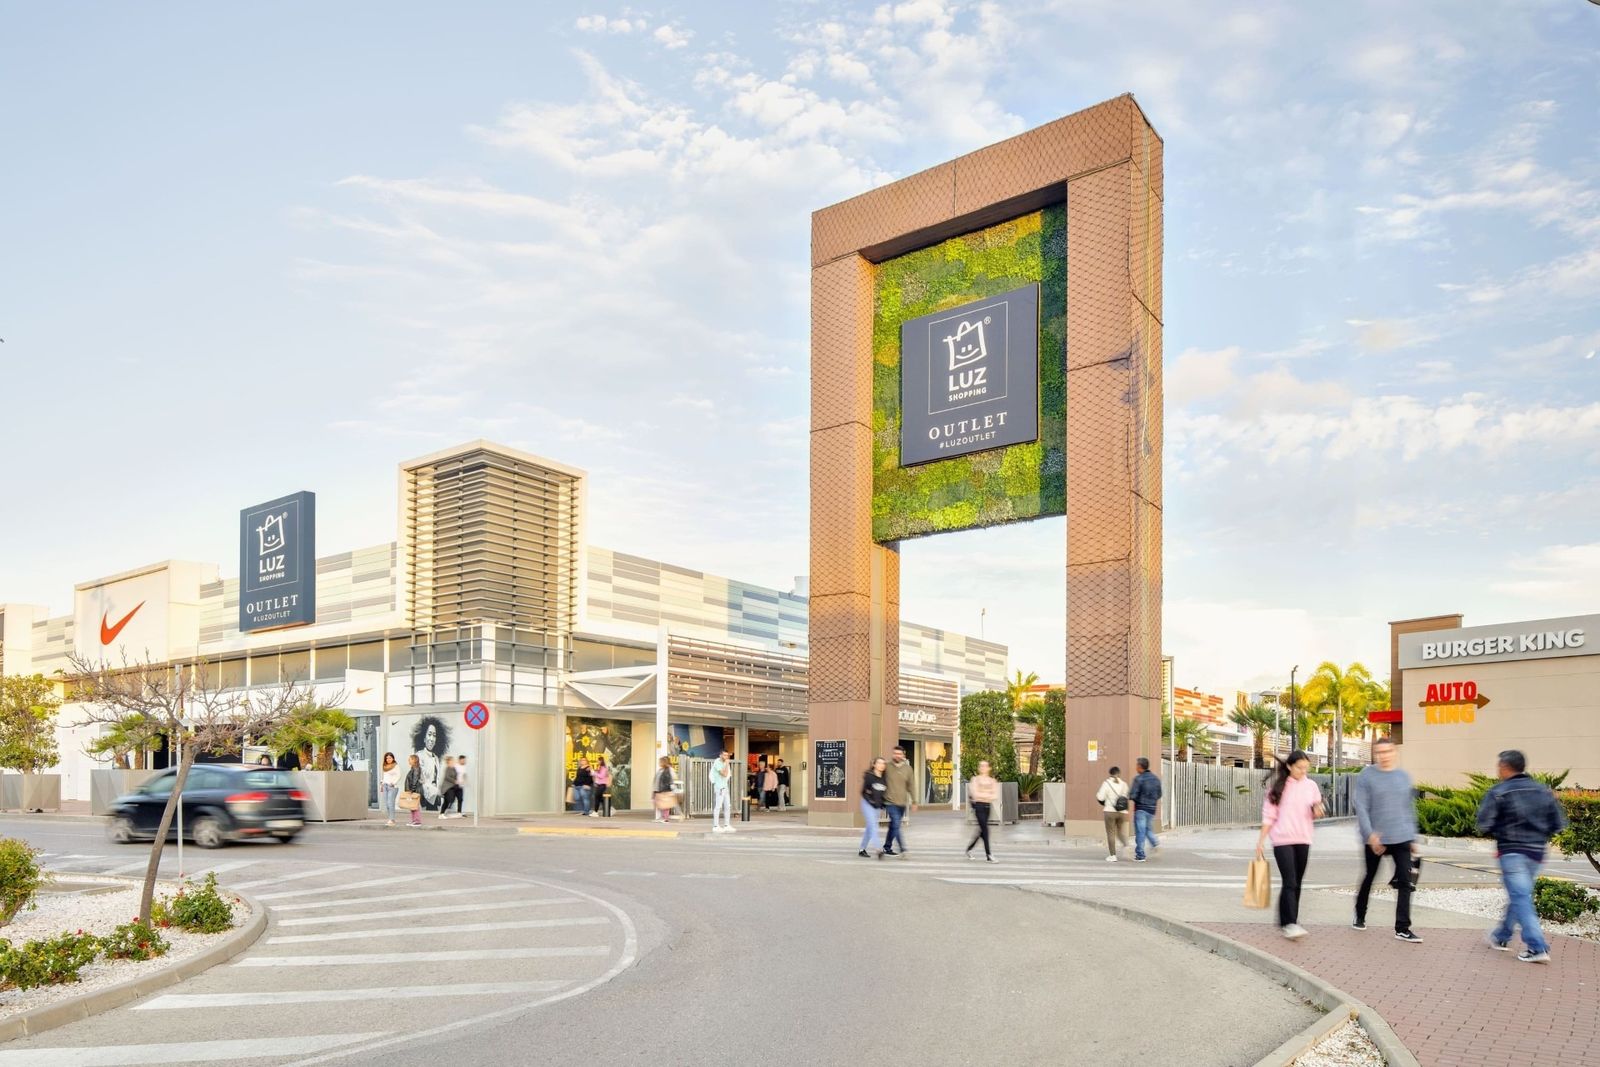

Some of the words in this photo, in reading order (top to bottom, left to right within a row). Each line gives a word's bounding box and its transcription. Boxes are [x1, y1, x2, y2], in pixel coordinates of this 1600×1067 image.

[949, 367, 987, 391] LUZ
[948, 387, 987, 401] SHOPPING
[929, 412, 1007, 439] OUTLET
[940, 431, 996, 448] #LUZOUTLET
[259, 555, 285, 573] LUZ
[259, 572, 285, 582] SHOPPING
[246, 594, 298, 614] OUTLET
[253, 610, 291, 621] #LUZOUTLET
[1422, 635, 1514, 660] BURGER
[1519, 628, 1585, 652] KING
[1425, 681, 1477, 702] AUTO
[1425, 703, 1476, 724] KING
